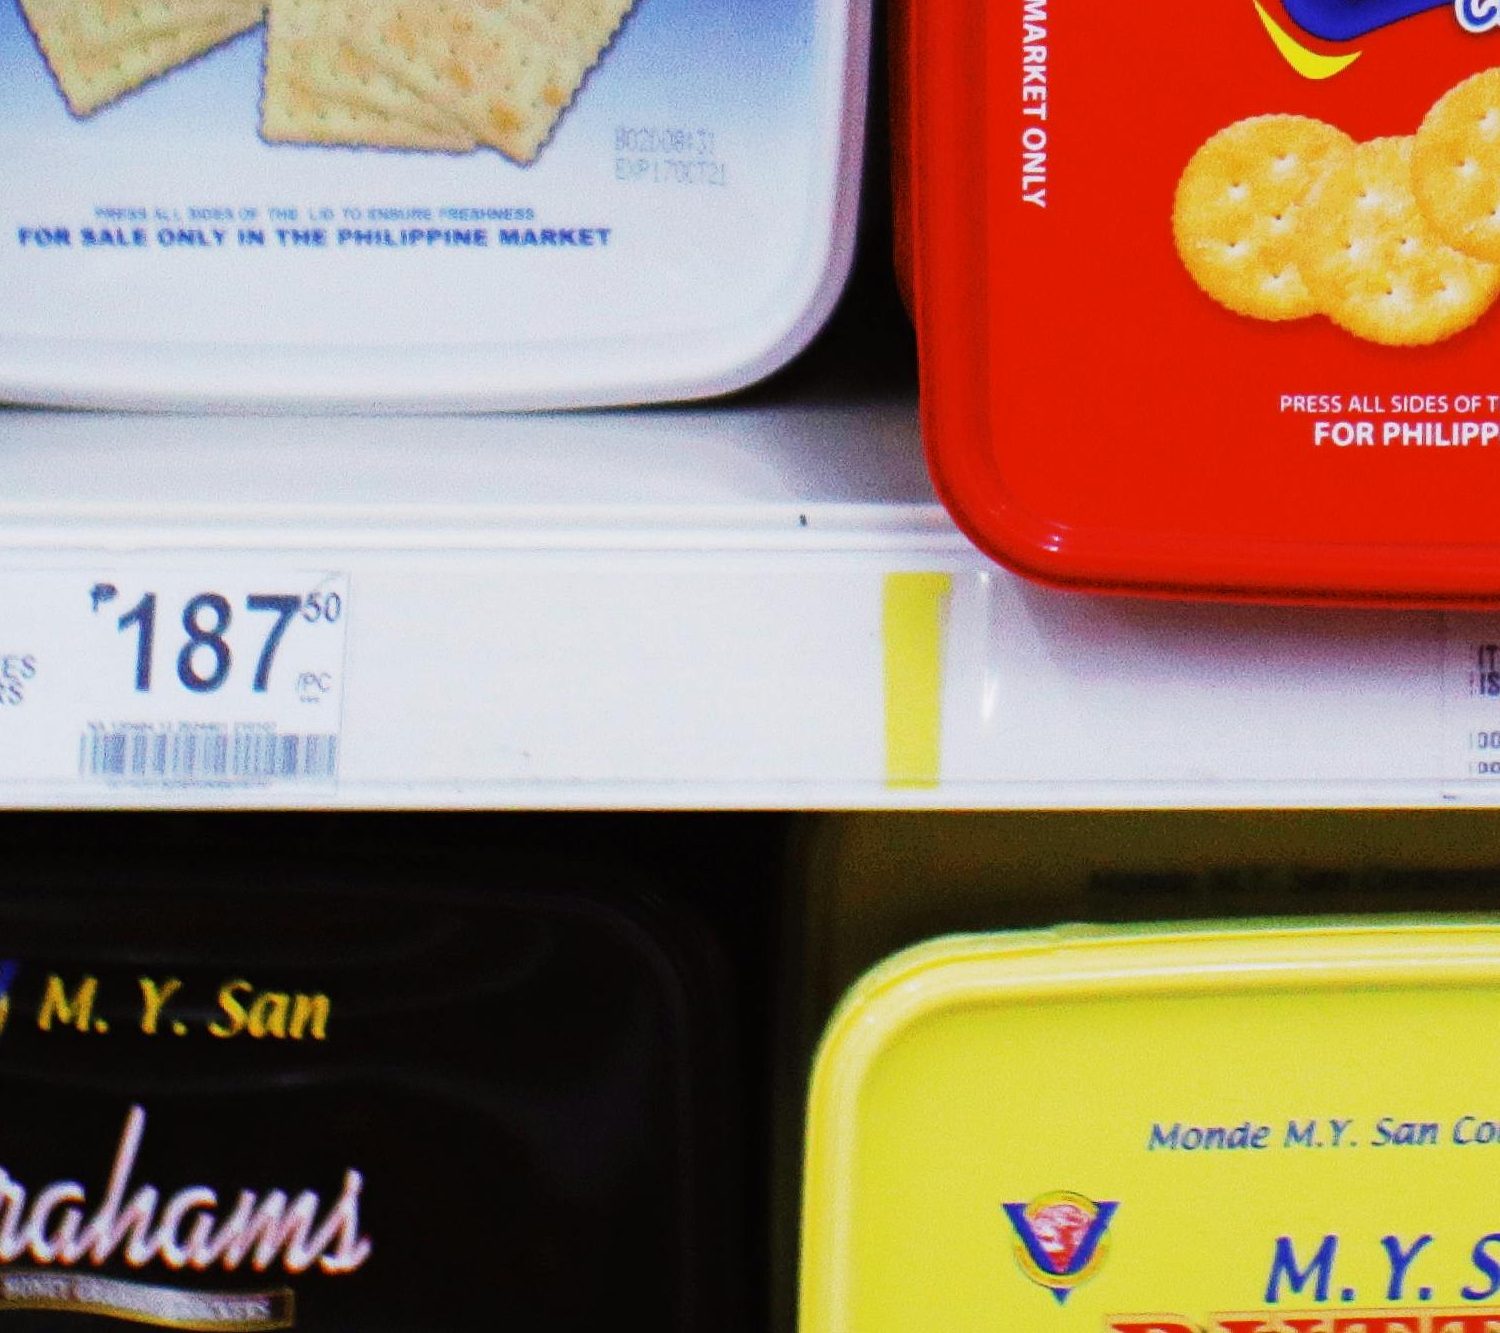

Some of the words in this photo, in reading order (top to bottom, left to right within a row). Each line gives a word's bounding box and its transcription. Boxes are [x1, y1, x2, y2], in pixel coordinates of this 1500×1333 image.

[1281, 395, 1342, 413] PRESS
[1348, 395, 1385, 413] ALL
[1391, 395, 1449, 413] SIDES
[1454, 395, 1481, 413] OF
[1315, 422, 1373, 446] FOR
[300, 592, 341, 622] 50
[39, 977, 108, 1033] M.
[140, 978, 186, 1035] Y.
[209, 981, 329, 1039] San
[1265, 1235, 1354, 1303] M.
[1381, 1235, 1432, 1300] Y.
